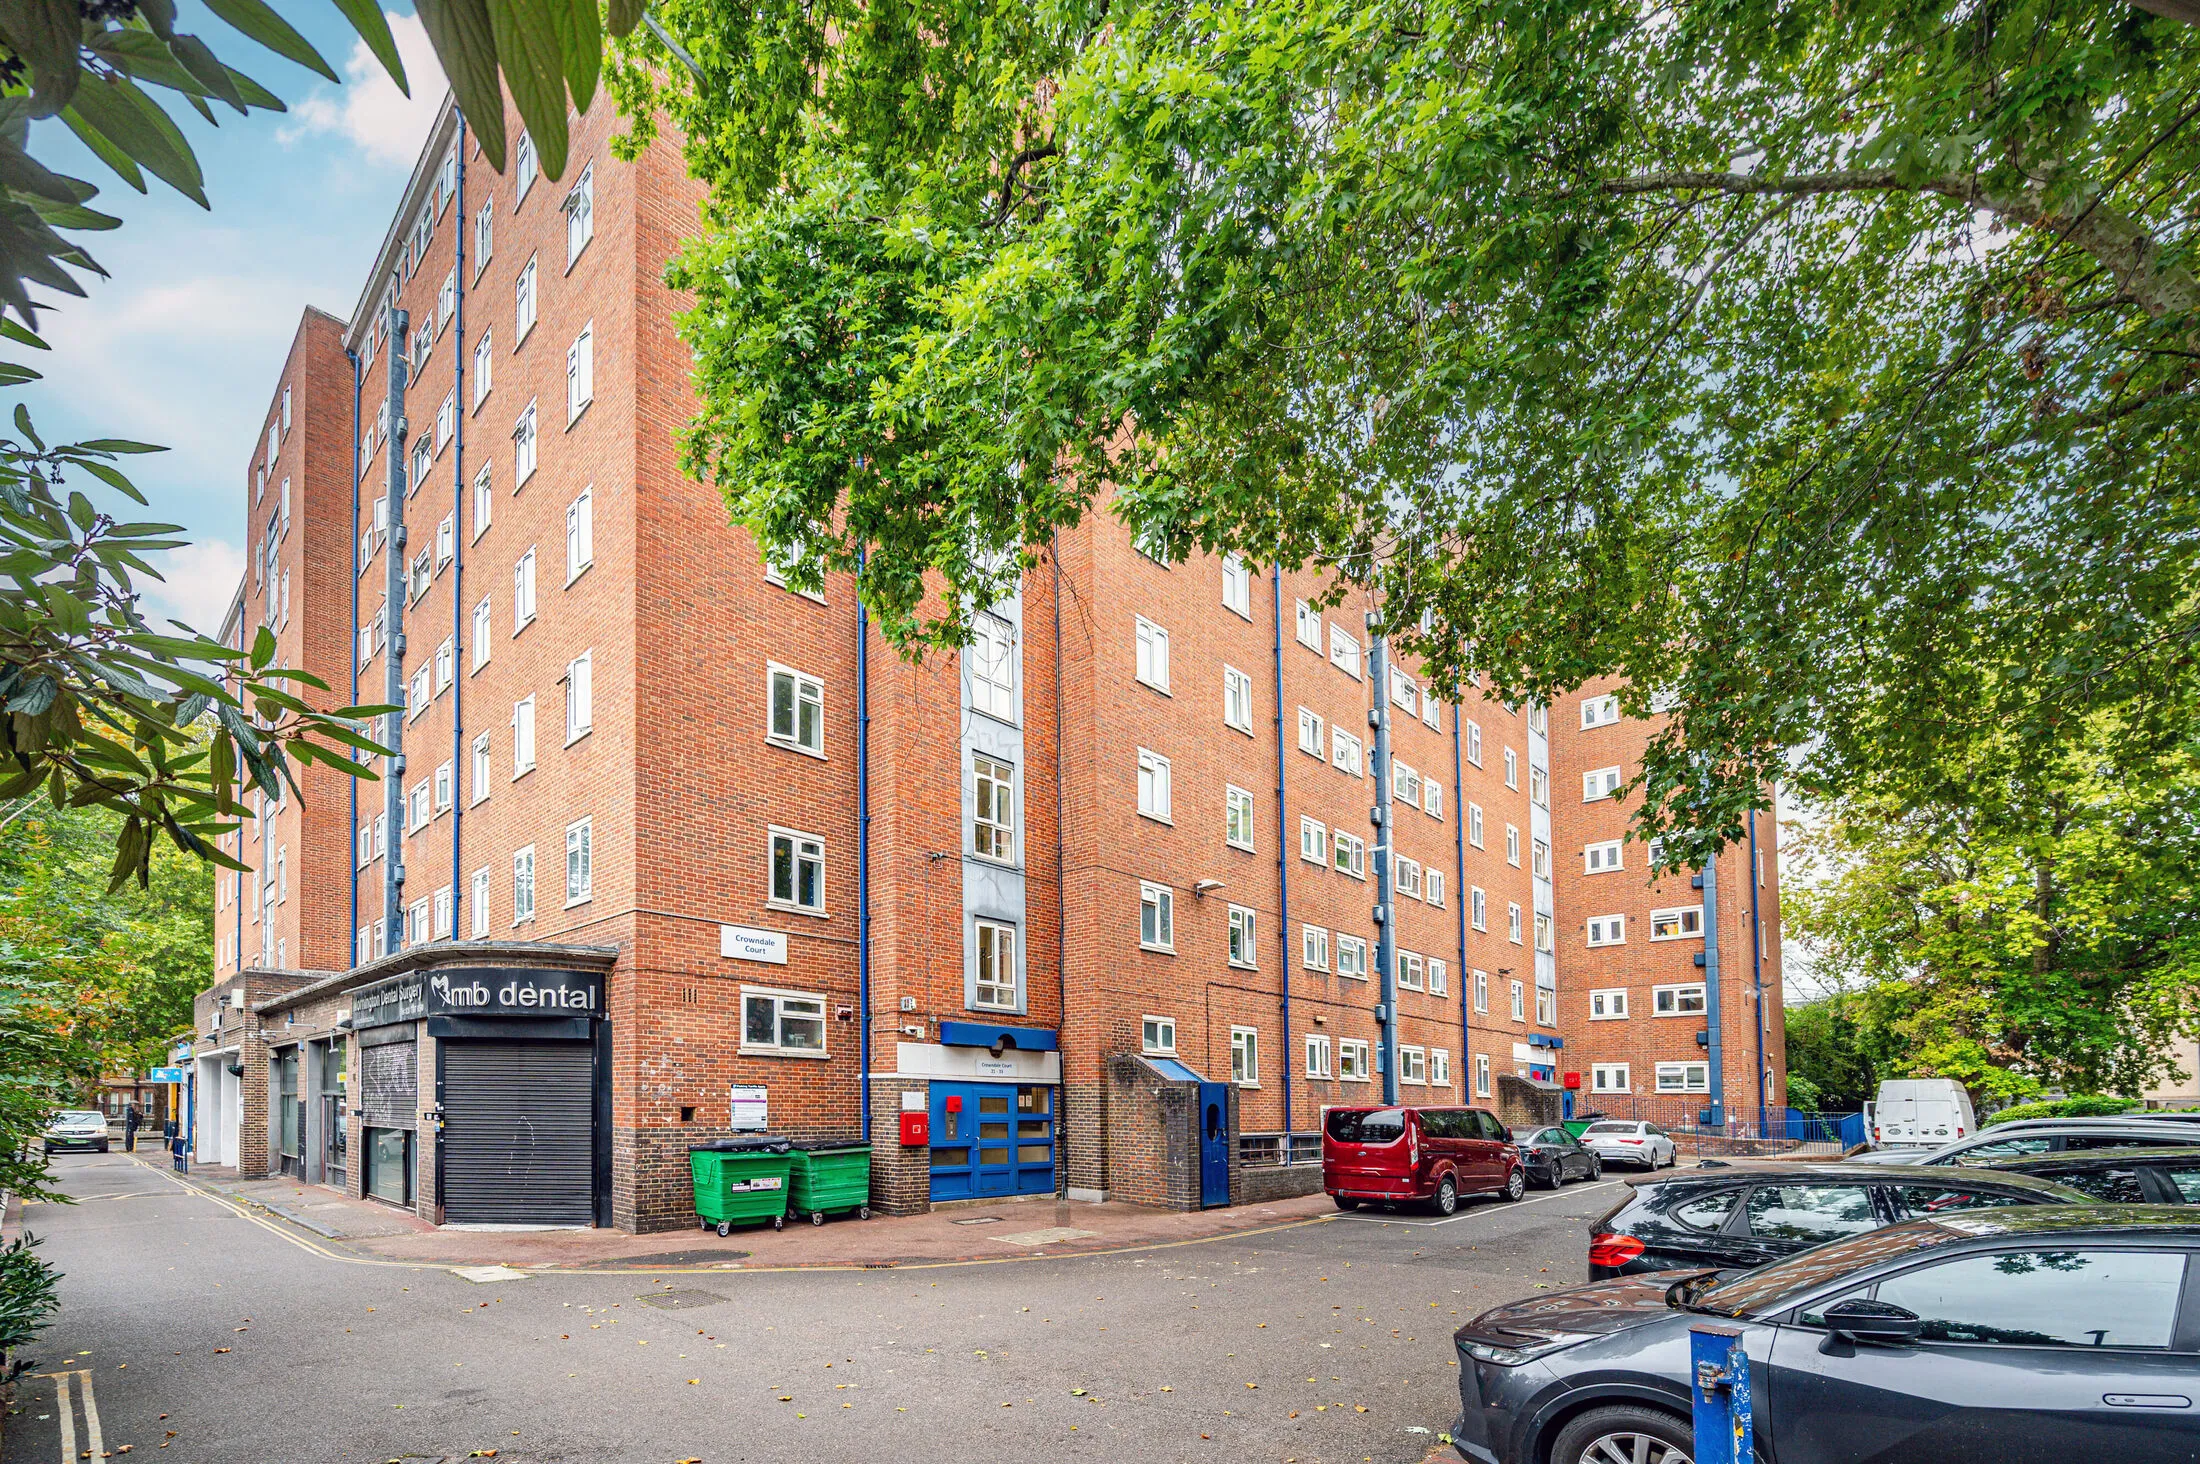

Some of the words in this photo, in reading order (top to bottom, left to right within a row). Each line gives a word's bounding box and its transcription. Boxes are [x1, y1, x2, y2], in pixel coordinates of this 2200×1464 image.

[735, 934, 776, 947] Crowndale
[744, 945, 766, 955] Court
[381, 985, 399, 1006] Dental
[399, 983, 423, 1004] Surgery
[451, 981, 491, 1007] mb
